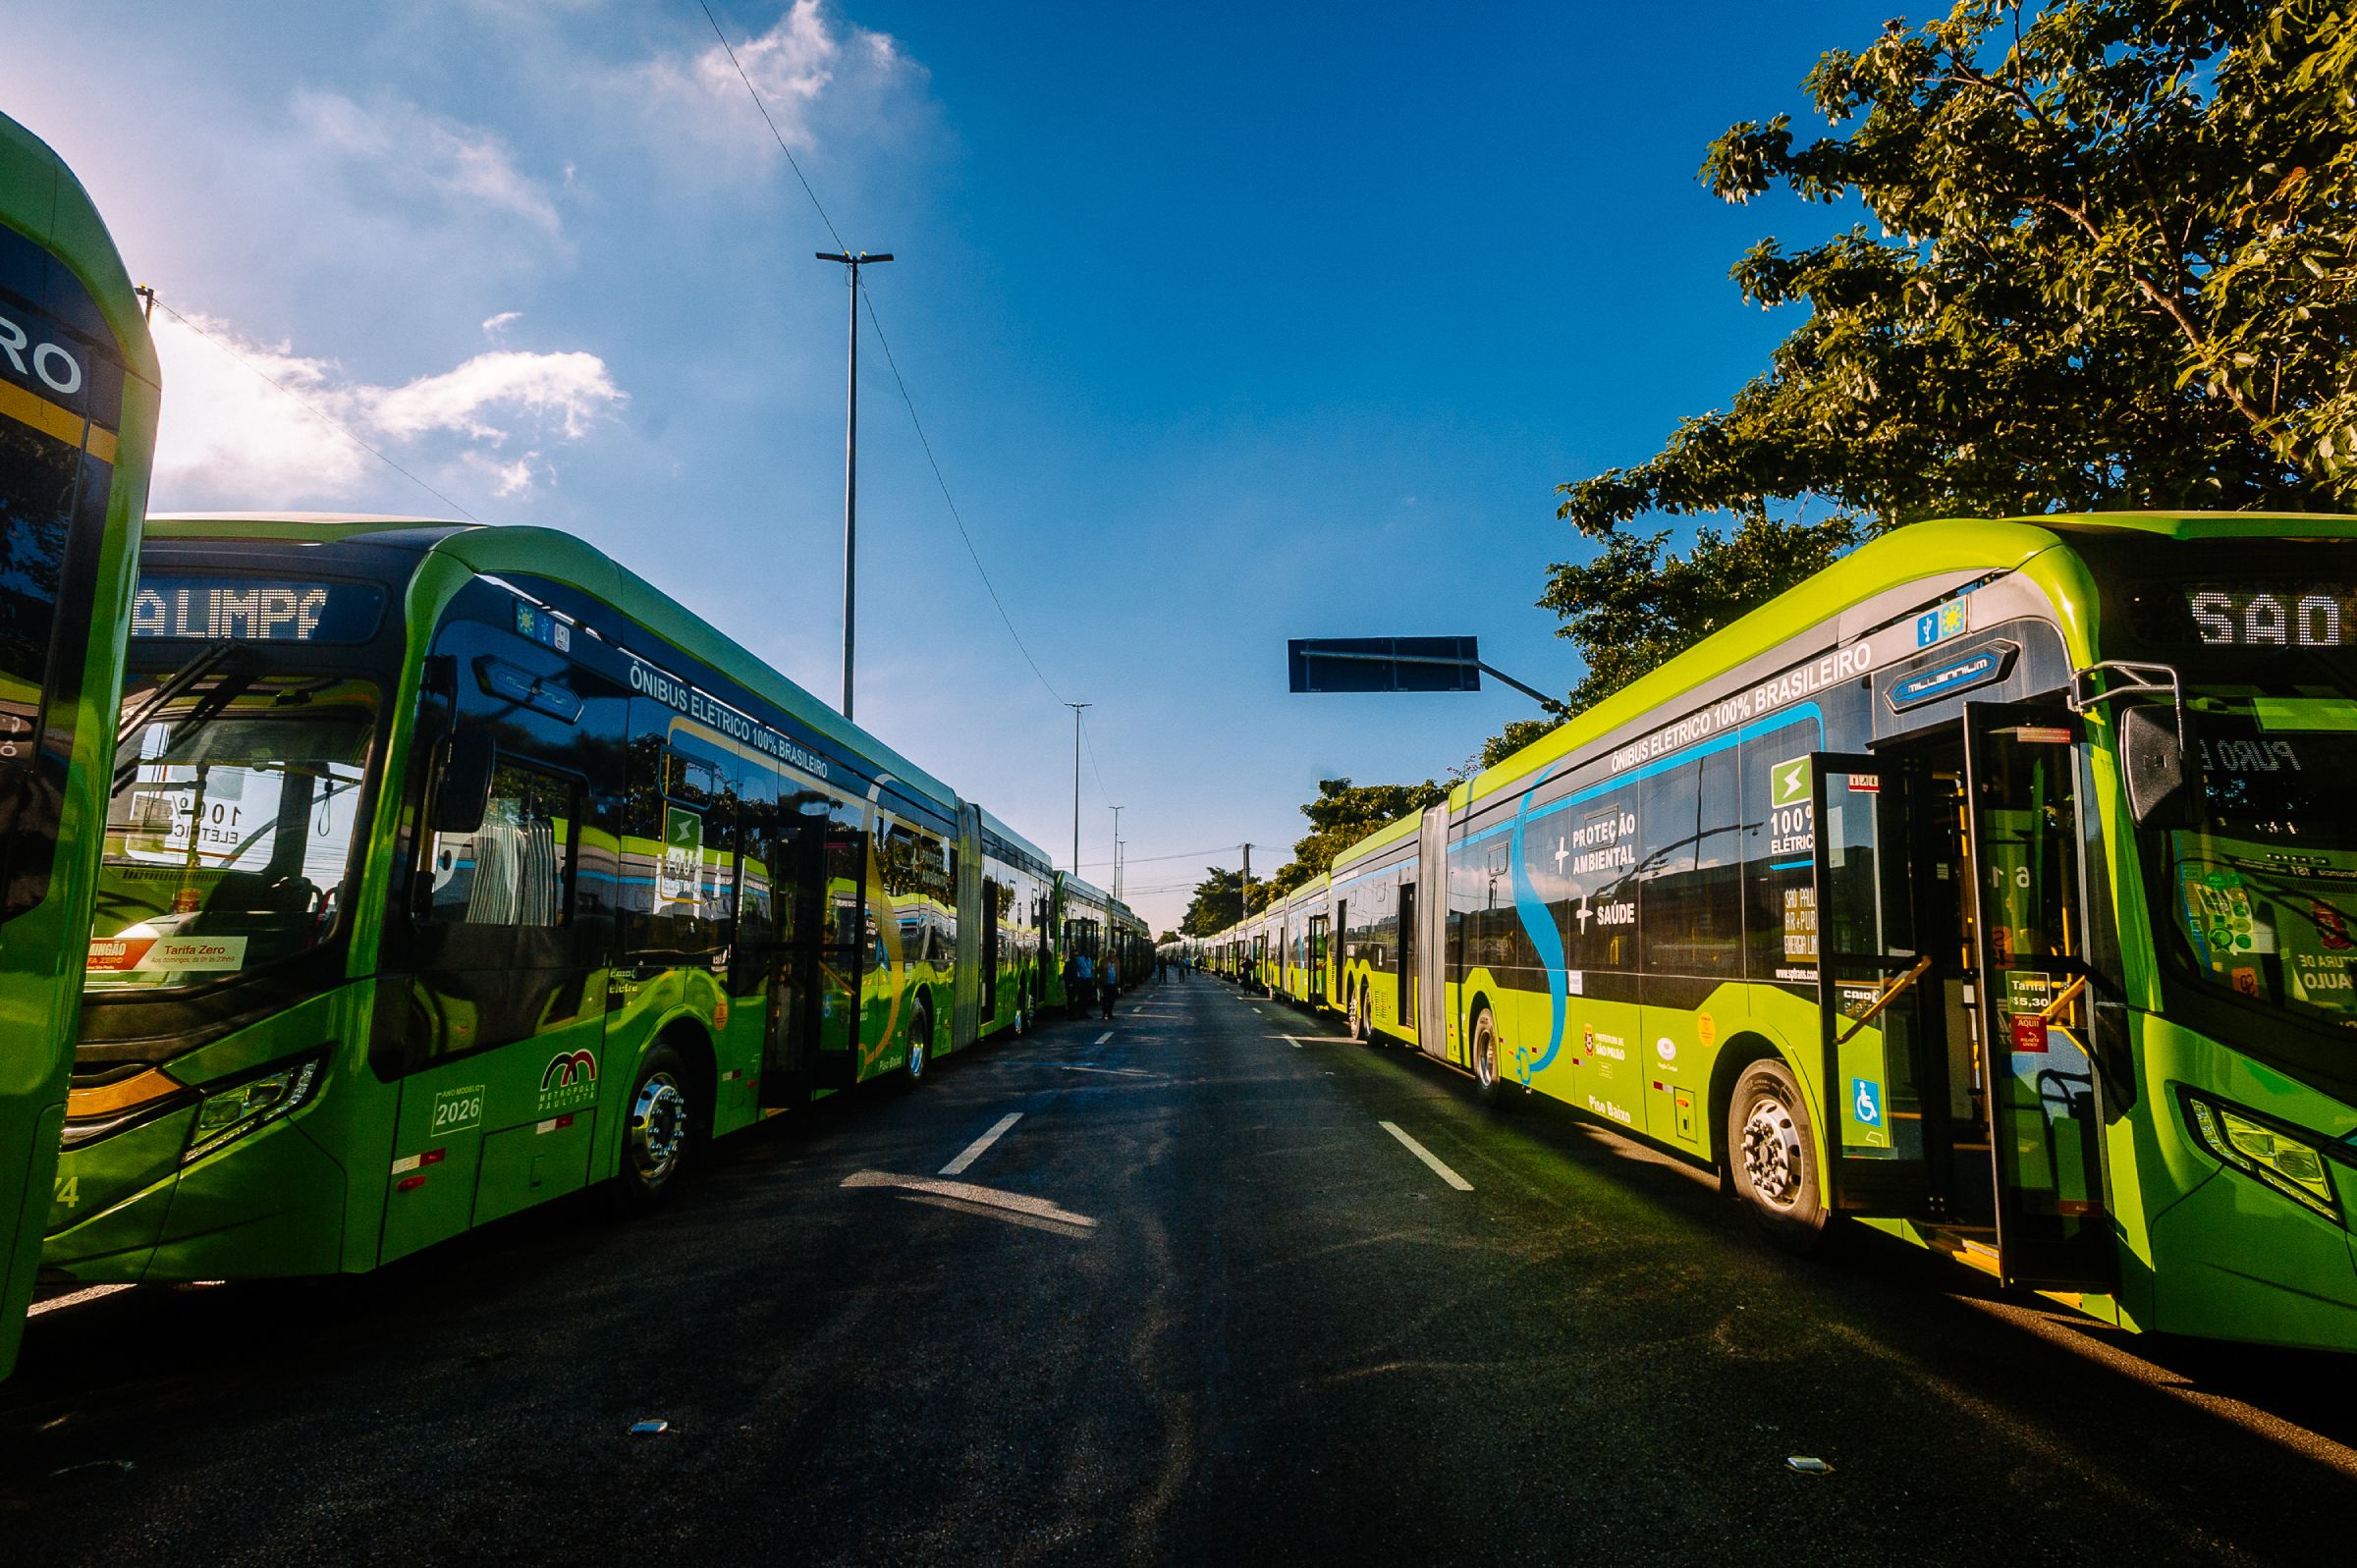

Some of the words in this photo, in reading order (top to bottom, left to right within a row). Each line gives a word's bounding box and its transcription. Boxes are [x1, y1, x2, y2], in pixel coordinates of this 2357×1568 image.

[630, 660, 687, 712] ÔNIBUS
[690, 694, 750, 741] ELÉTRICO
[752, 727, 777, 755] 100%
[779, 739, 828, 779] BRASILEIRO
[1611, 741, 1649, 773] ÔNIBUS
[1650, 712, 1711, 757] ELÉTRICO
[1714, 700, 1751, 730] 100%
[1754, 643, 1871, 714] BRASILEIRO
[1572, 813, 1635, 849] PROTEÇÃO
[1573, 844, 1635, 875] AMBIENTAL
[1596, 901, 1635, 926] SAÚDE
[164, 946, 195, 955] Tarifa
[199, 945, 226, 955] Zero
[2011, 980, 2046, 992] Tarifa
[435, 1097, 480, 1126] 2026
[1588, 1094, 1606, 1113] Piso
[1606, 1101, 1631, 1124] Baixo
